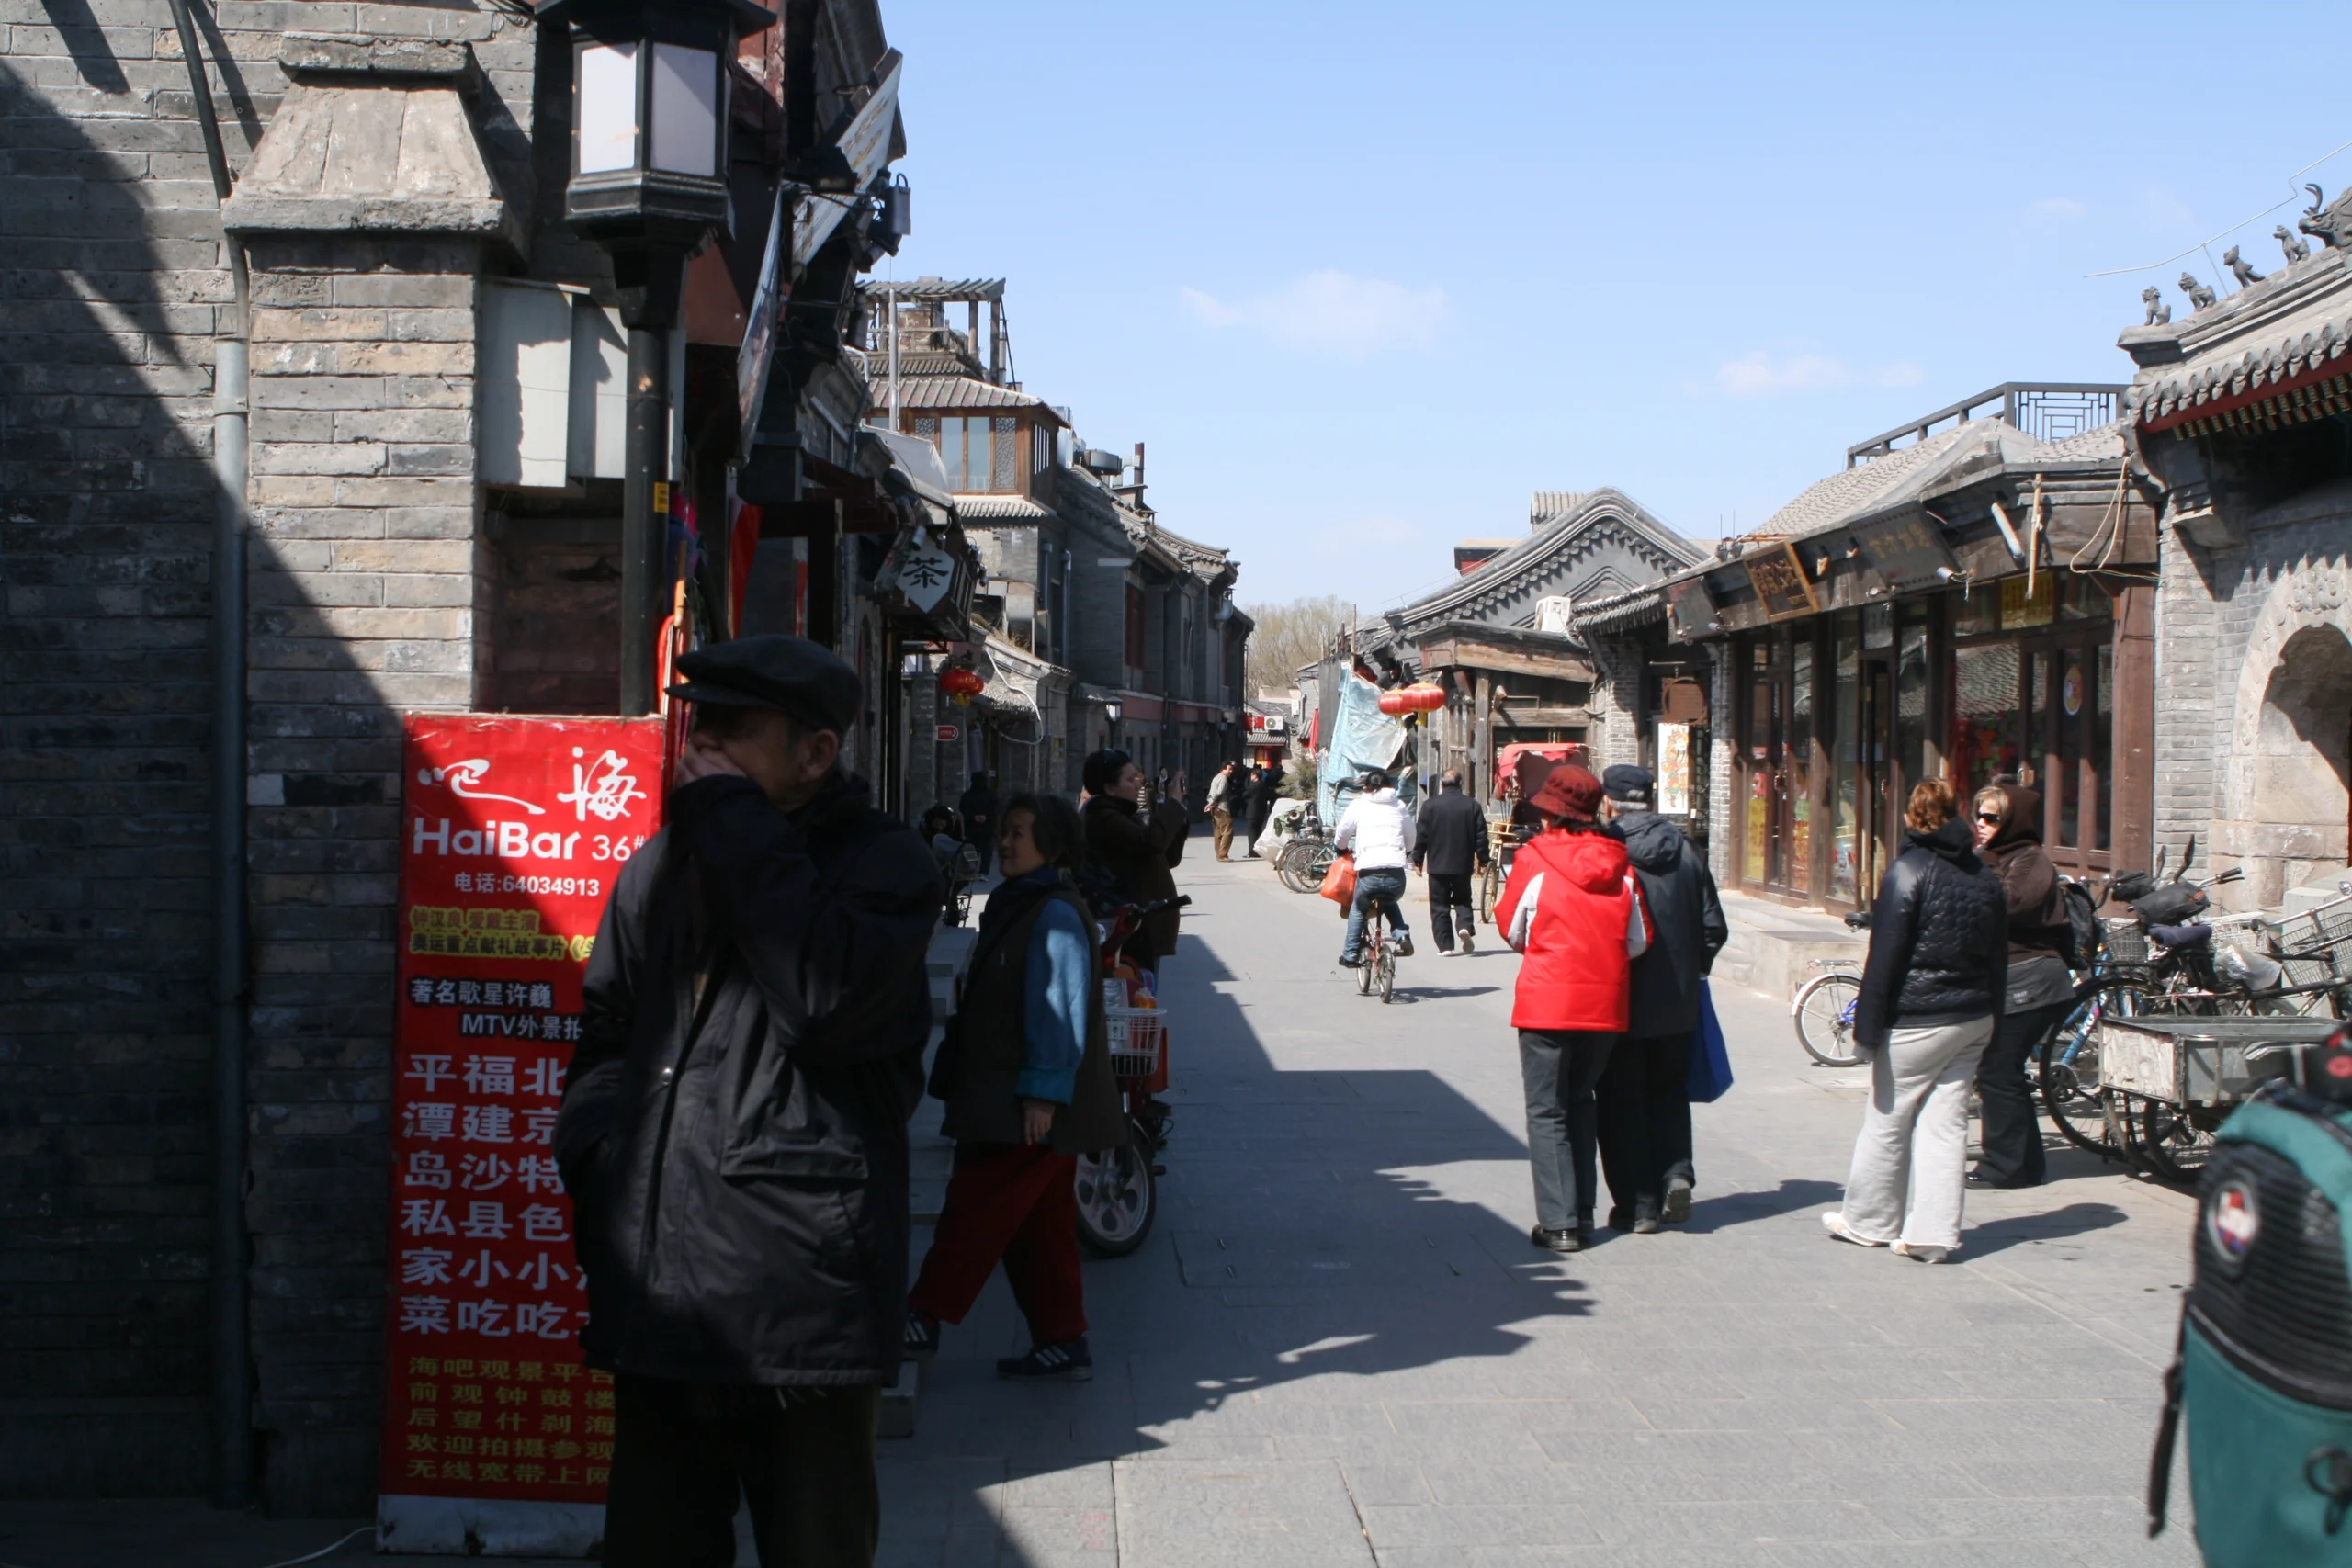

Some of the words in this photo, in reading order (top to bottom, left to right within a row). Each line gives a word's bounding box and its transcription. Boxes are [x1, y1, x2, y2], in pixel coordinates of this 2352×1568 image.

[903, 557, 949, 589] 茶
[413, 817, 582, 860] HaiBar
[411, 977, 553, 1009] 著名歌星许巍
